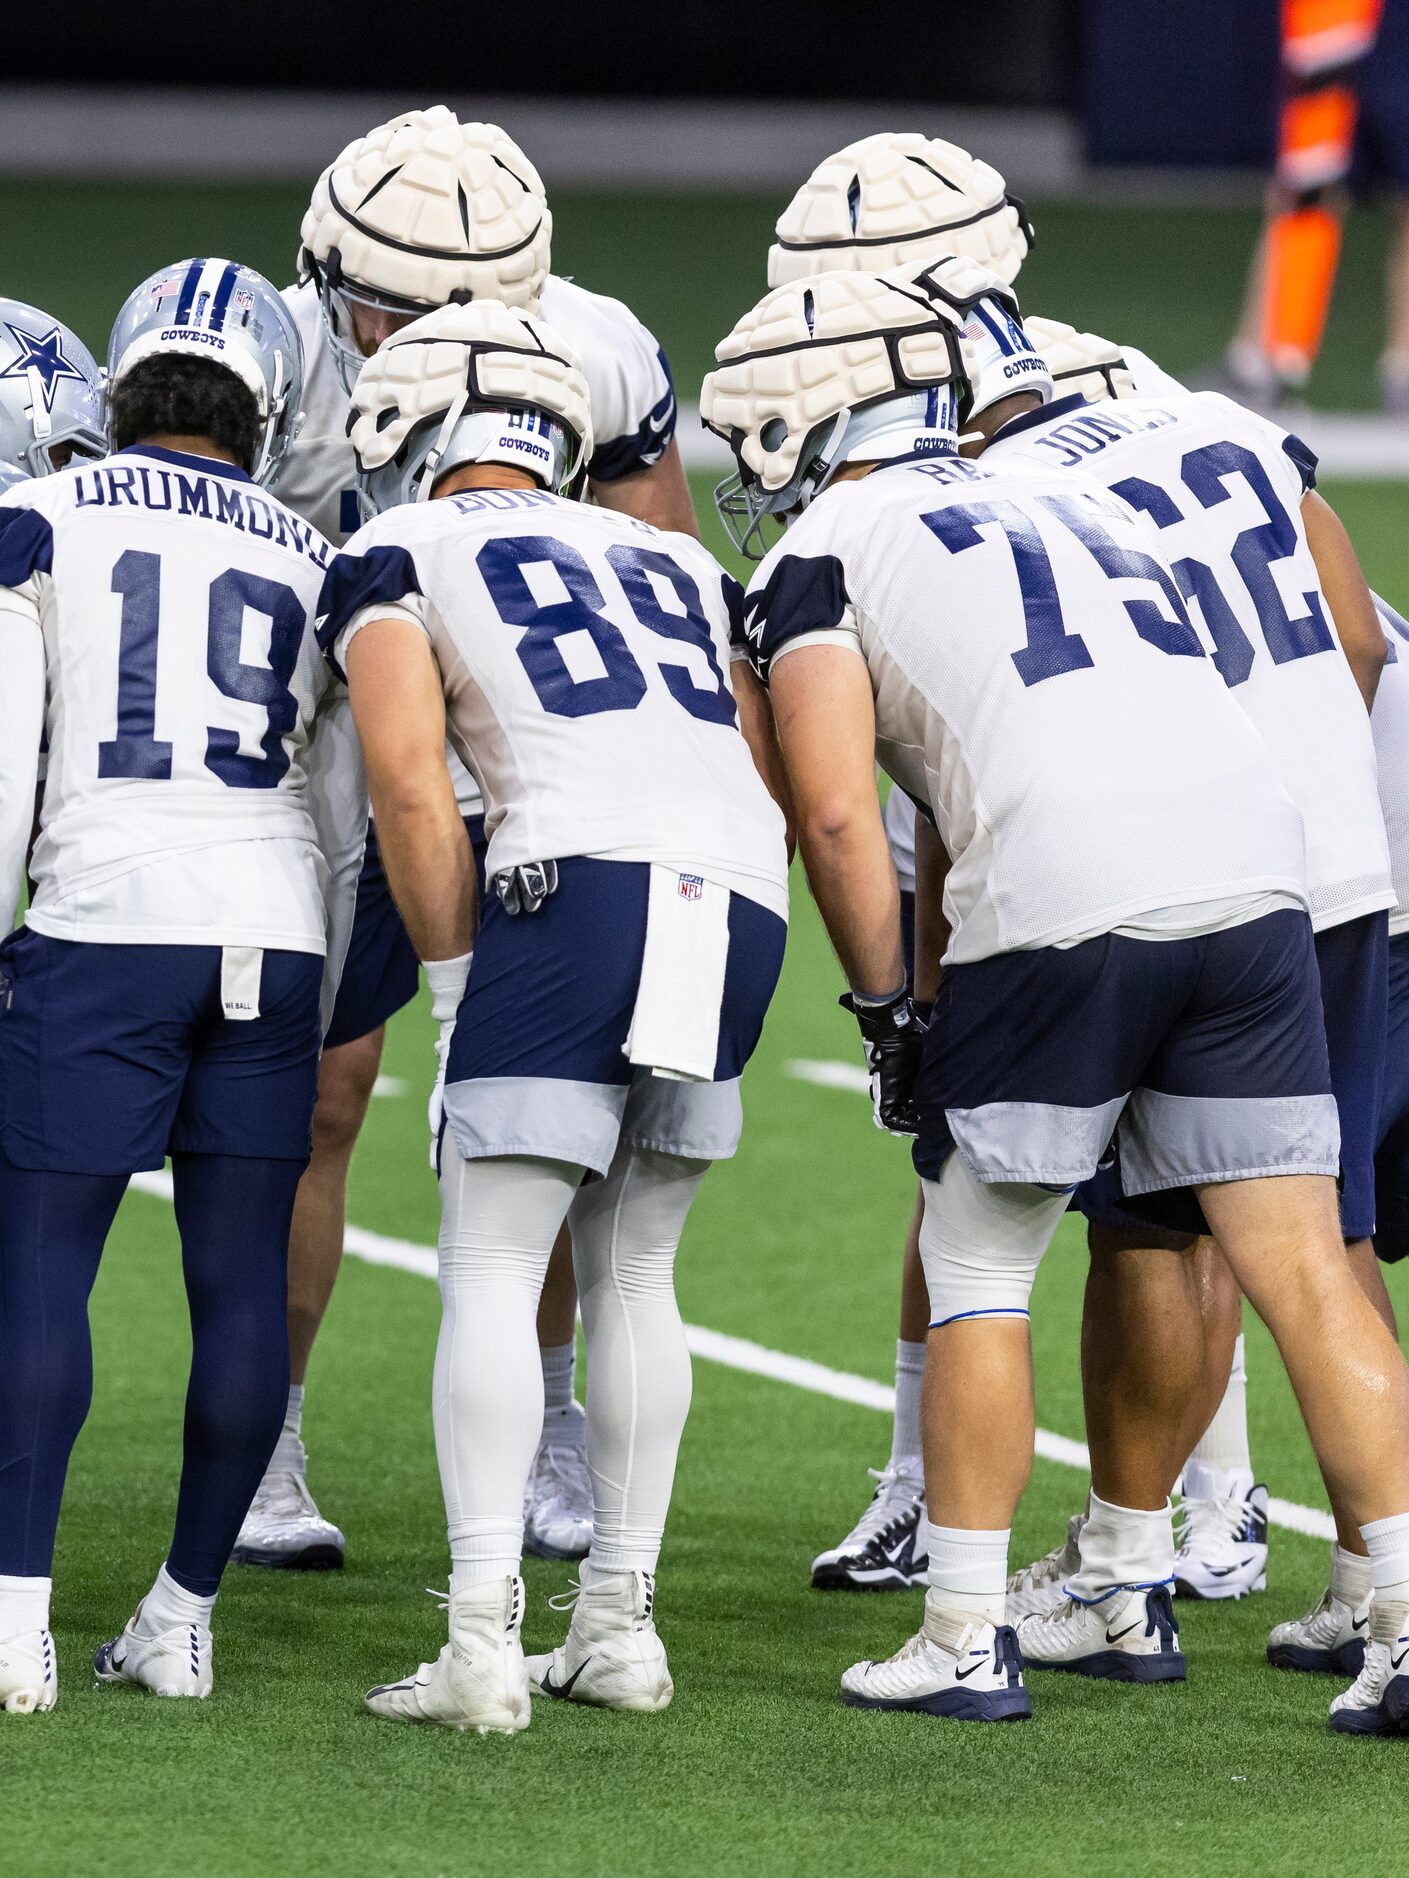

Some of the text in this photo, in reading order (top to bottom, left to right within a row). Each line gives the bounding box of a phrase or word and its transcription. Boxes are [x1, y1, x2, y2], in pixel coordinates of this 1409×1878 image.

[498, 436, 551, 462] COWBOYS
[475, 535, 739, 731] 89
[919, 492, 1207, 688] 75
[98, 549, 307, 789] 19
[680, 881, 701, 898] NFL
[225, 1002, 234, 1010] WE
